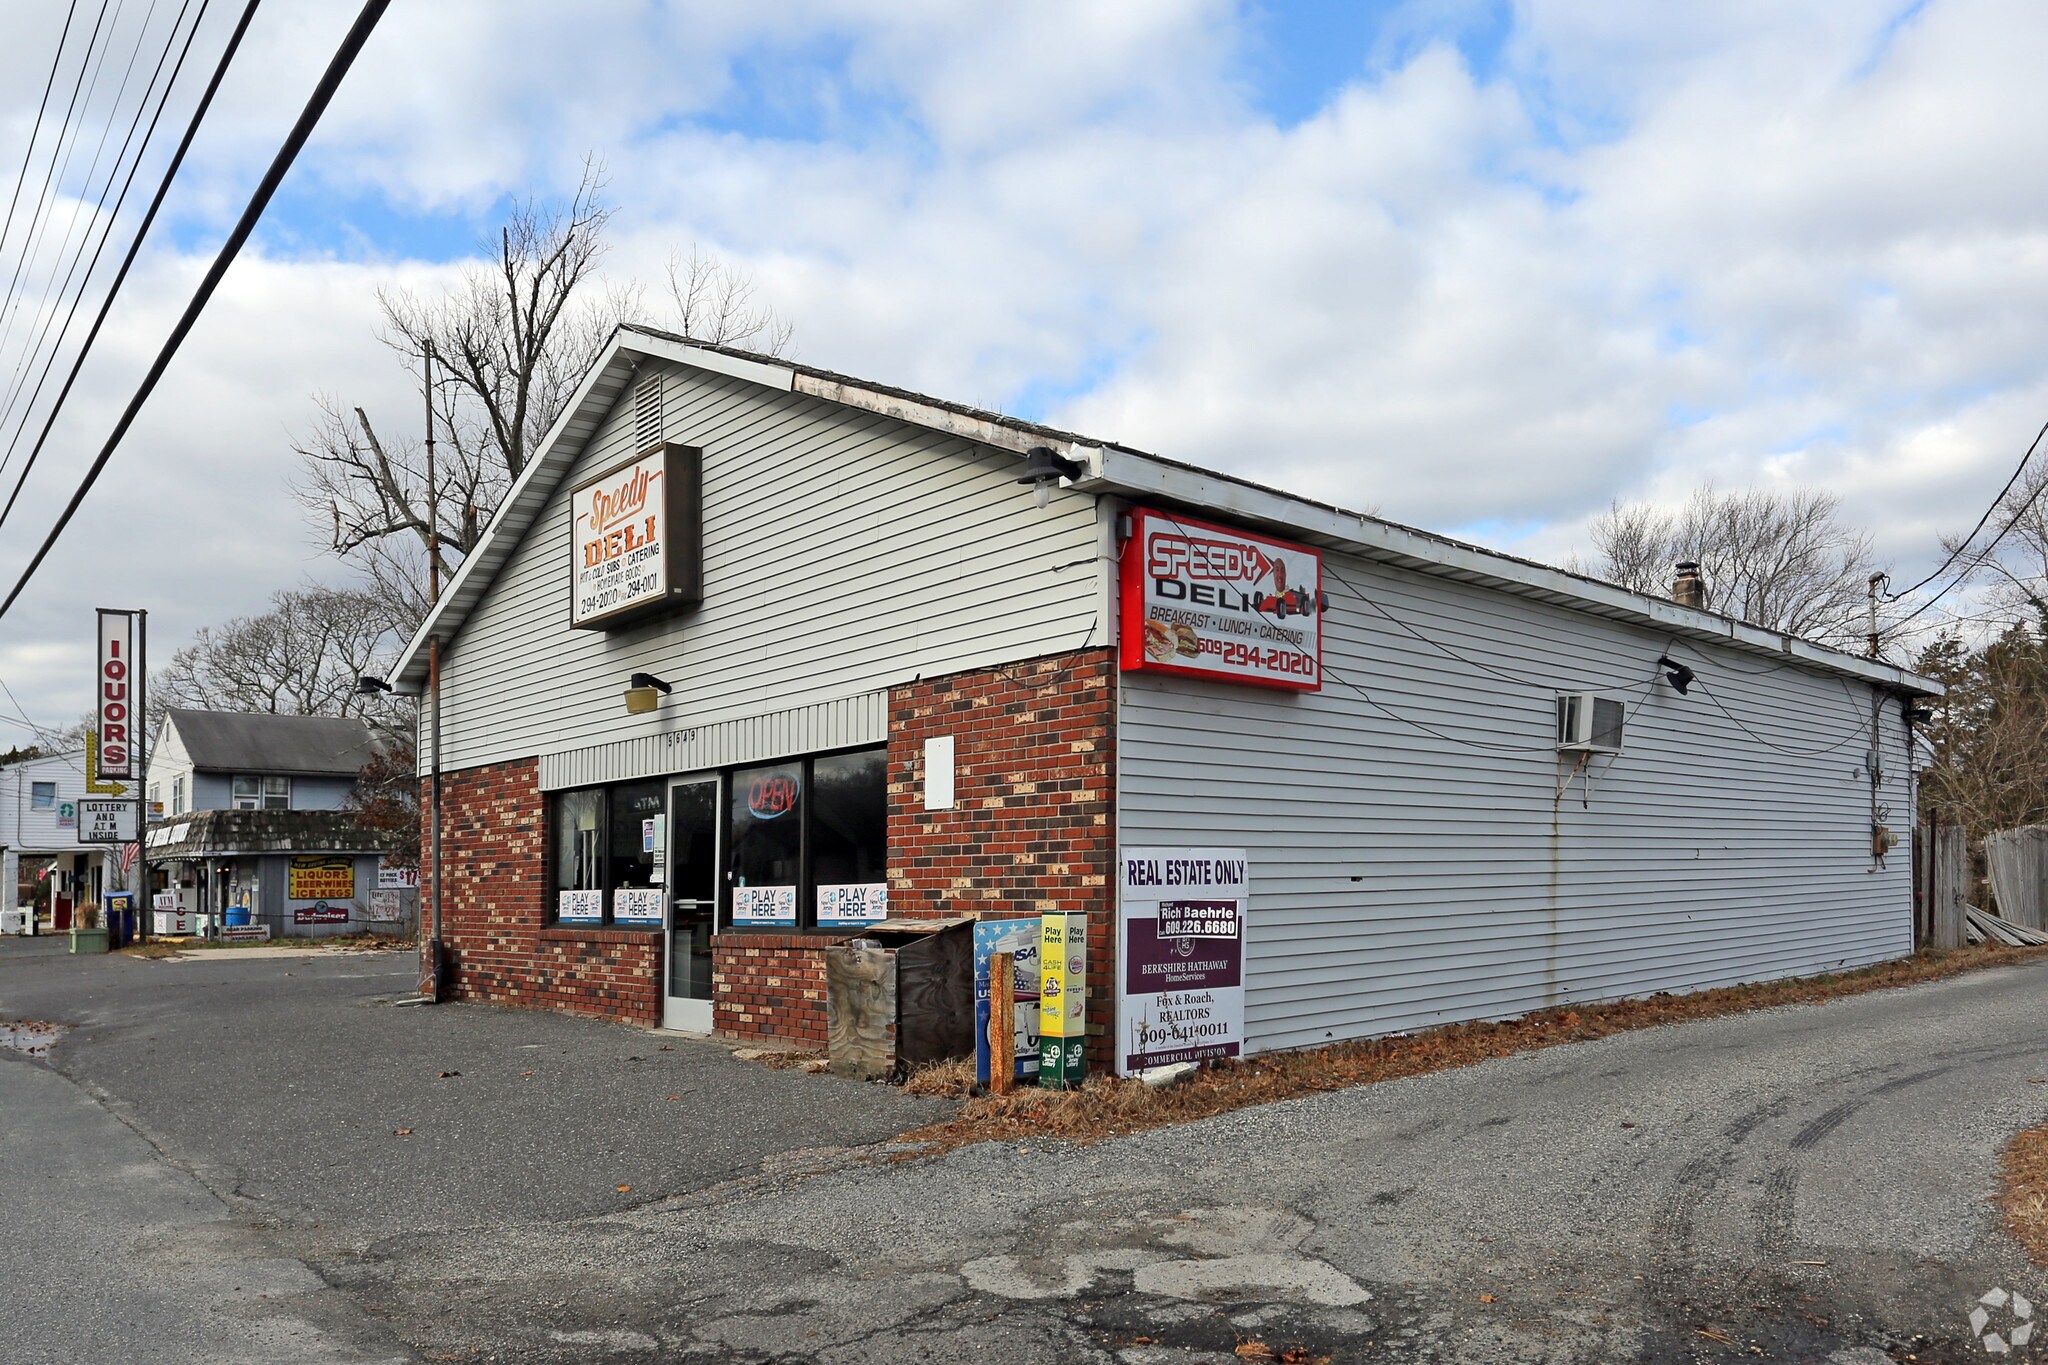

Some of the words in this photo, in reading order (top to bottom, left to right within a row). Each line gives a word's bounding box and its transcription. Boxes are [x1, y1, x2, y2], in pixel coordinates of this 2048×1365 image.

[590, 466, 649, 535] Speedy
[584, 514, 656, 569] DELI
[606, 559, 620, 574] SUBS
[627, 542, 660, 566] CATERING
[1150, 534, 1259, 580] SPEEDY
[581, 588, 618, 615] 294-2020
[627, 572, 657, 598] 294-0101
[1156, 578, 1249, 612] DELI
[1150, 605, 1210, 628] BREAKFAST
[1218, 618, 1252, 636] LUNCH
[1260, 625, 1303, 645] CATERING
[1199, 637, 1223, 656] 609
[1223, 641, 1313, 676] 294-2020
[102, 766, 128, 775] PARKING
[749, 778, 797, 812] OPEN
[86, 803, 128, 812] LOTTERY
[96, 812, 115, 821] AND
[88, 831, 119, 840] INSIDE
[296, 870, 348, 879] LIQUORS
[1128, 859, 1162, 886] REAL
[1166, 859, 1211, 885] ESTATE
[1215, 859, 1245, 885] ONLY
[572, 893, 589, 903] PLAY
[628, 892, 648, 903] PLAY
[751, 890, 776, 903] PLAY
[838, 888, 867, 902] PLAY
[176, 893, 186, 930] ICE
[572, 904, 588, 915] HERE
[628, 904, 647, 916] HERE
[751, 904, 776, 917] HERE
[838, 902, 867, 917] HERE
[1184, 907, 1234, 919] Baehrle
[1045, 927, 1061, 937] Play
[1069, 927, 1084, 937] Play
[1165, 920, 1235, 935] 609.226.6680
[1044, 935, 1062, 944] Here
[1068, 936, 1085, 944] Here
[1142, 963, 1187, 975] BERKSHIRE
[1187, 960, 1229, 972] HATHAWAY
[1165, 973, 1206, 983] HomeServices
[1156, 995, 1173, 1008] Fox
[1175, 994, 1182, 1006] &
[1184, 991, 1214, 1006] Roach,
